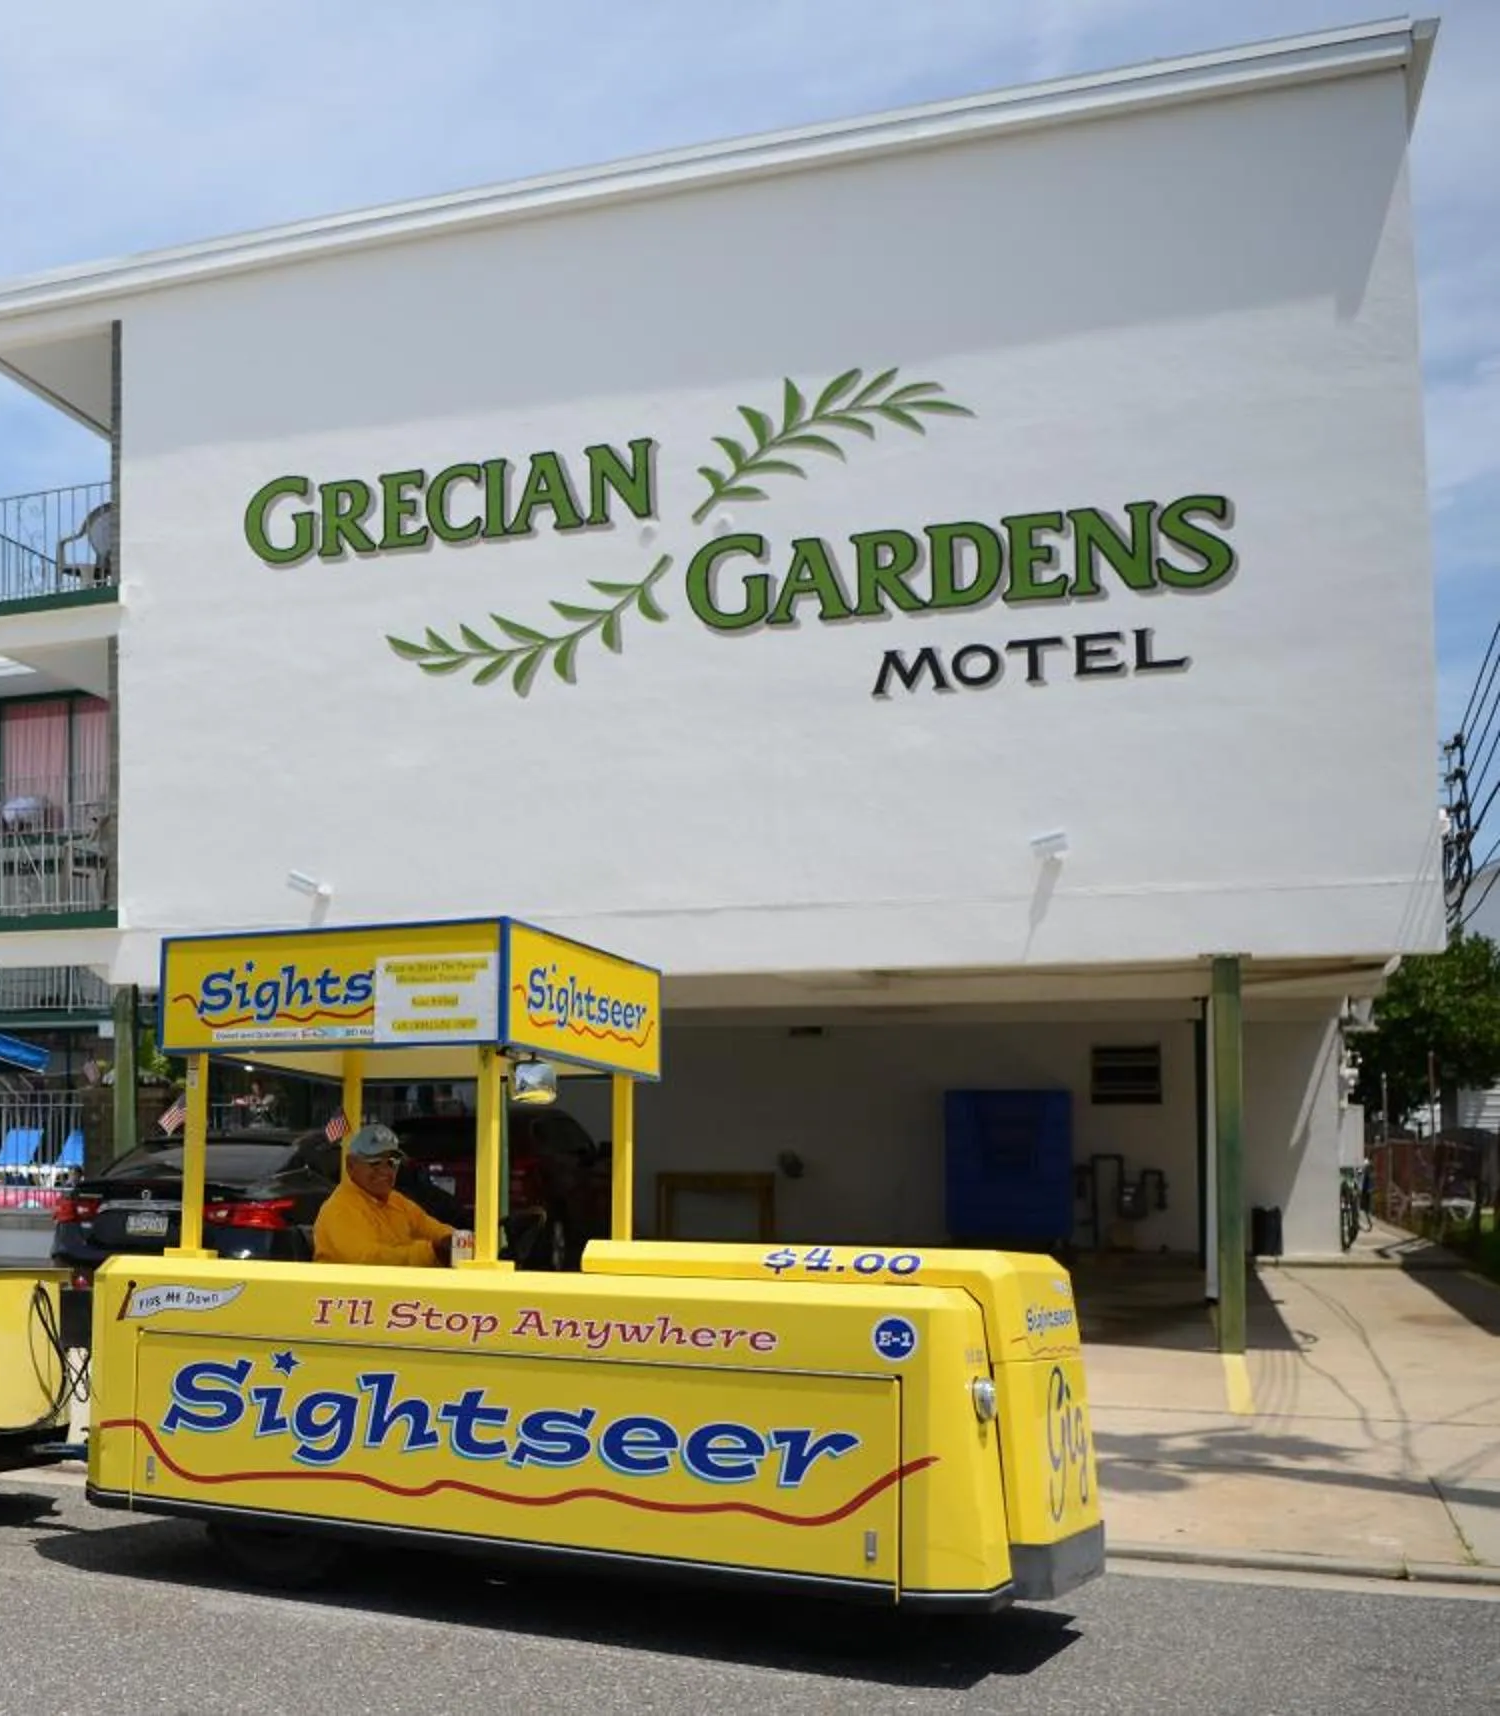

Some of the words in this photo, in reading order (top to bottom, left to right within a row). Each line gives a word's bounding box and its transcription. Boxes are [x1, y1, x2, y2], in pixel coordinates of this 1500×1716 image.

[244, 437, 656, 568] GRECIAN
[685, 494, 1236, 633] GARDENS
[872, 628, 1189, 698] MOTEL
[527, 963, 647, 1031] Sightseer
[764, 1247, 922, 1276] $4.00
[313, 1298, 375, 1327] I'll
[386, 1300, 500, 1343] Stop
[511, 1308, 779, 1352] Anywhere
[160, 1350, 862, 1489] Sightseer
